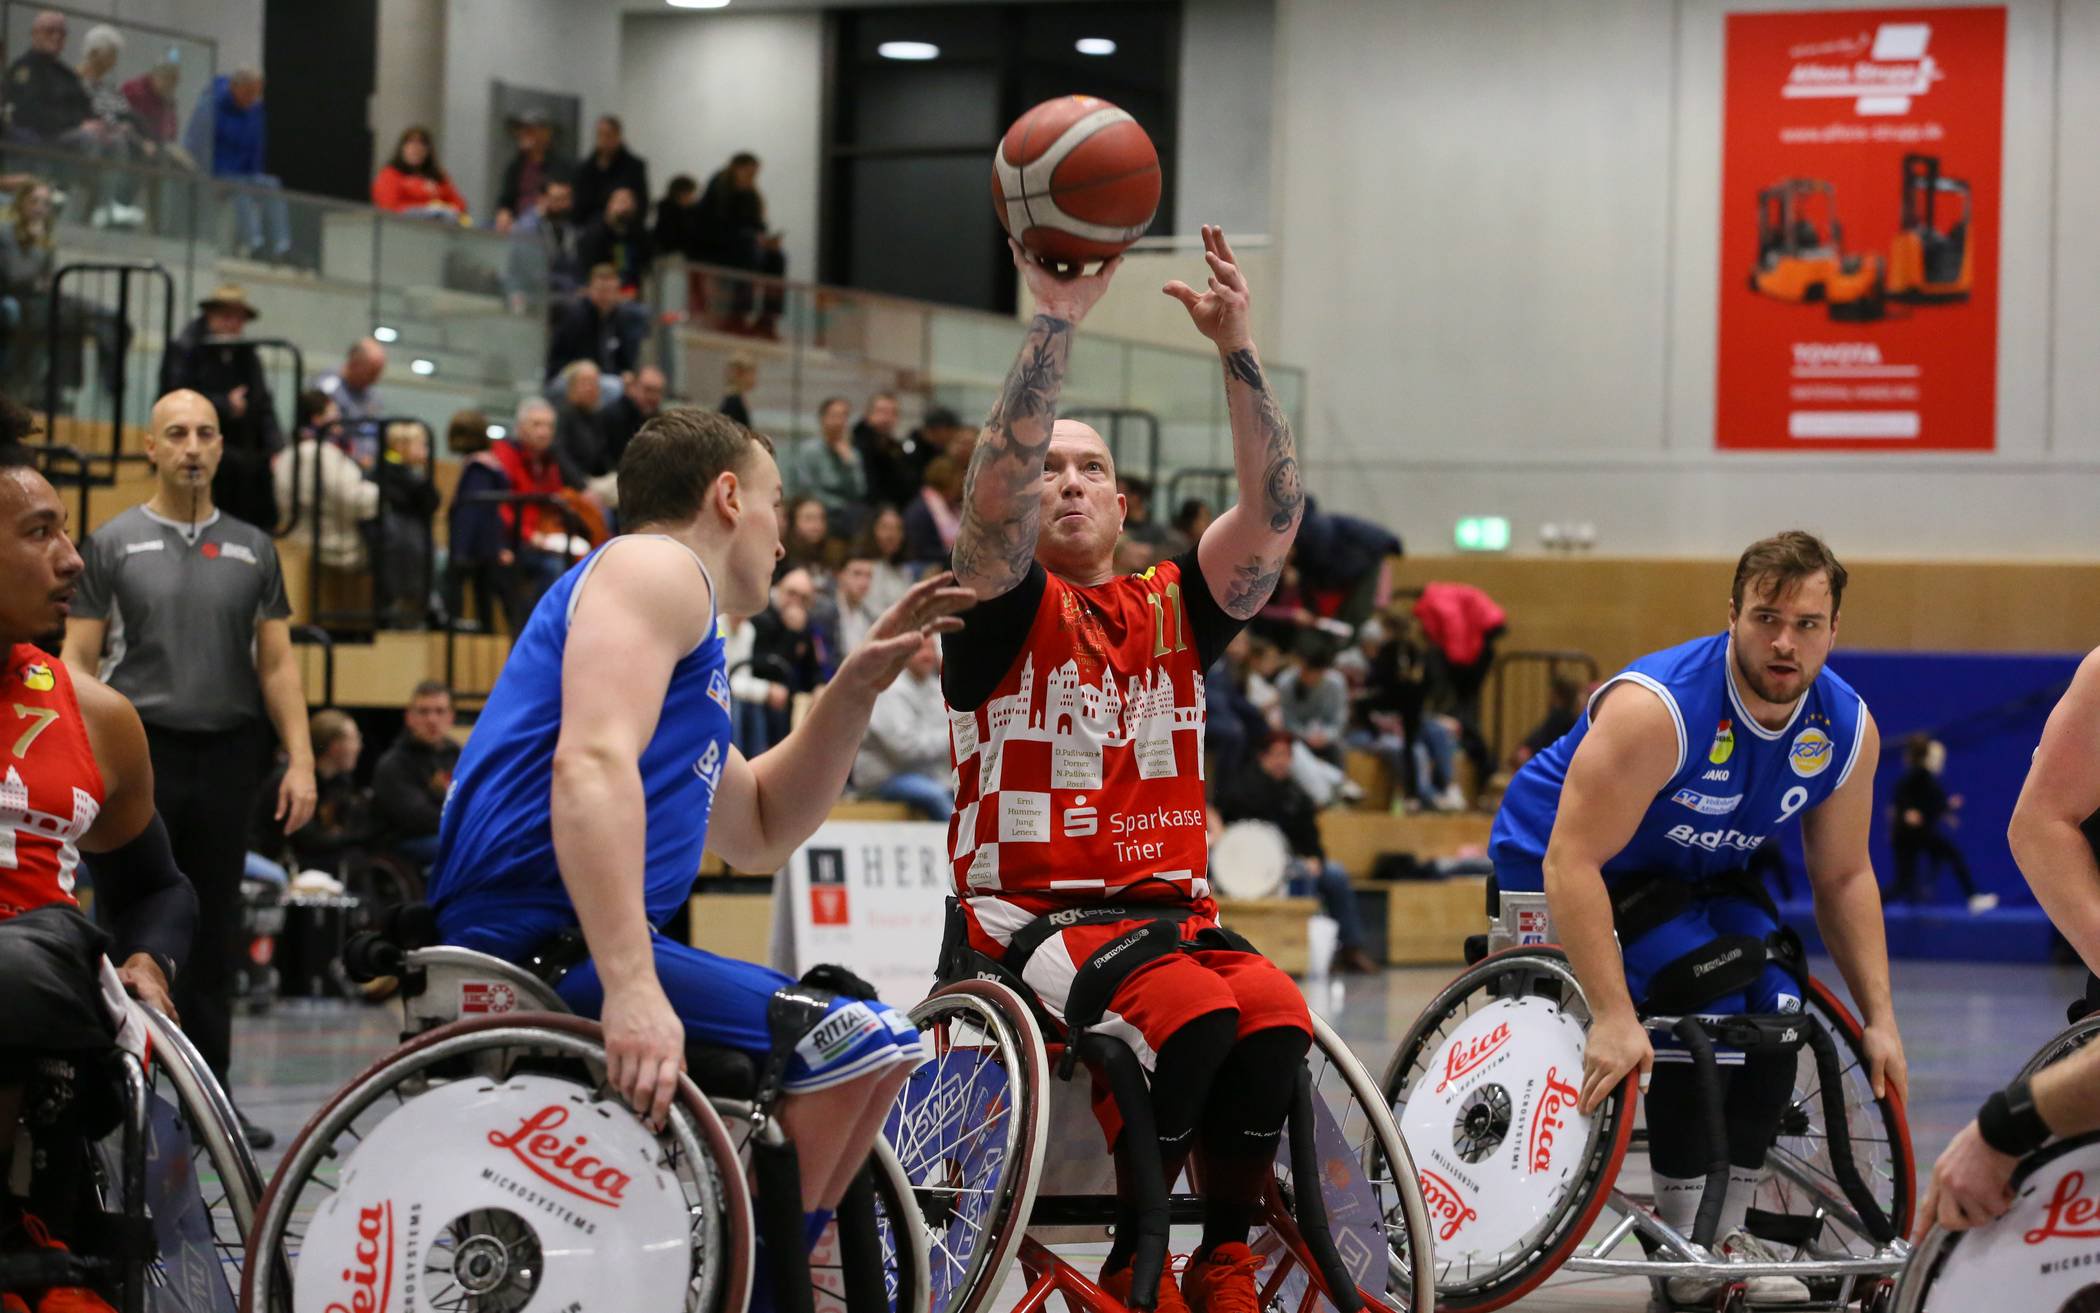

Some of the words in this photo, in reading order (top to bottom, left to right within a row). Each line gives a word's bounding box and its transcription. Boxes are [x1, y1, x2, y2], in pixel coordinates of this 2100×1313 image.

[1147, 581, 1188, 659] 11
[12, 703, 60, 760] 7
[1790, 741, 1833, 758] RSV
[1702, 769, 1730, 781] JAKO
[1015, 819, 1034, 828] Jung
[1110, 805, 1202, 834] Sparkasse
[1774, 785, 1808, 824] 9
[861, 846, 939, 888] HER
[1113, 840, 1164, 863] Trier
[812, 1007, 869, 1050] RITTAL
[1435, 1021, 1512, 1094] Leica
[1528, 1066, 1579, 1175] Leica
[487, 1104, 633, 1209] Leica
[481, 1167, 598, 1235] MICROSYSTEMS
[1663, 1184, 1703, 1192] JAKO
[325, 1200, 394, 1313] eica
